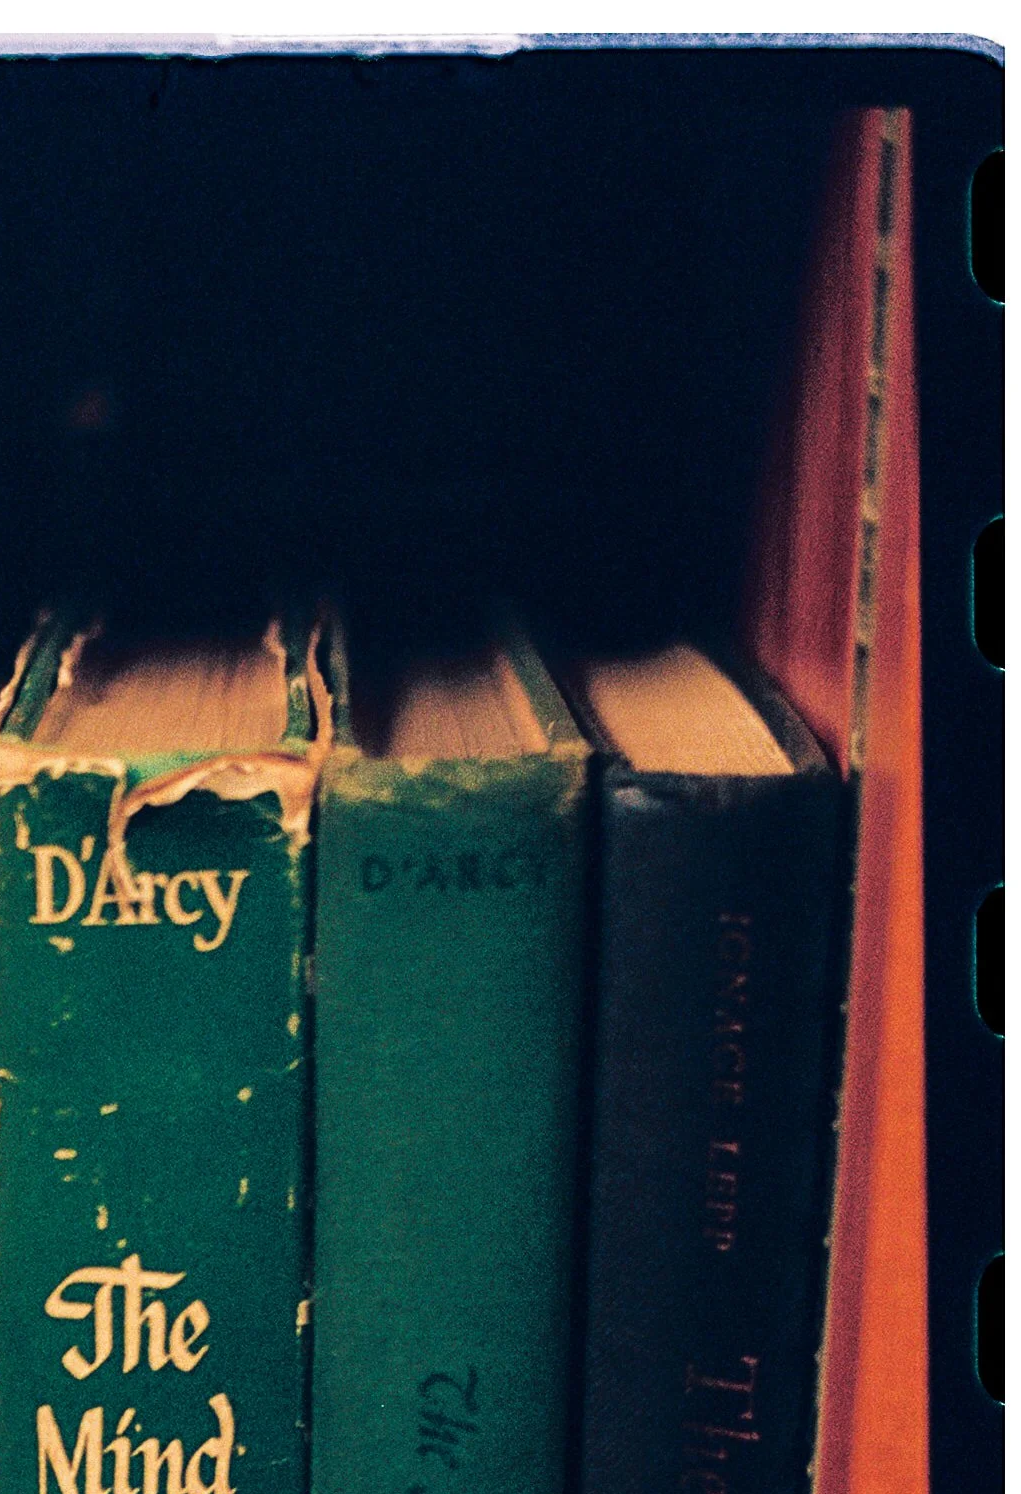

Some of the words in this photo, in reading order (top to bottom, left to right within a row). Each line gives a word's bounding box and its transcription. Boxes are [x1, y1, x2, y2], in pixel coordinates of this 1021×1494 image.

[28, 834, 250, 952] D'Arcy
[44, 1254, 211, 1380] The
[416, 1362, 478, 1472] The
